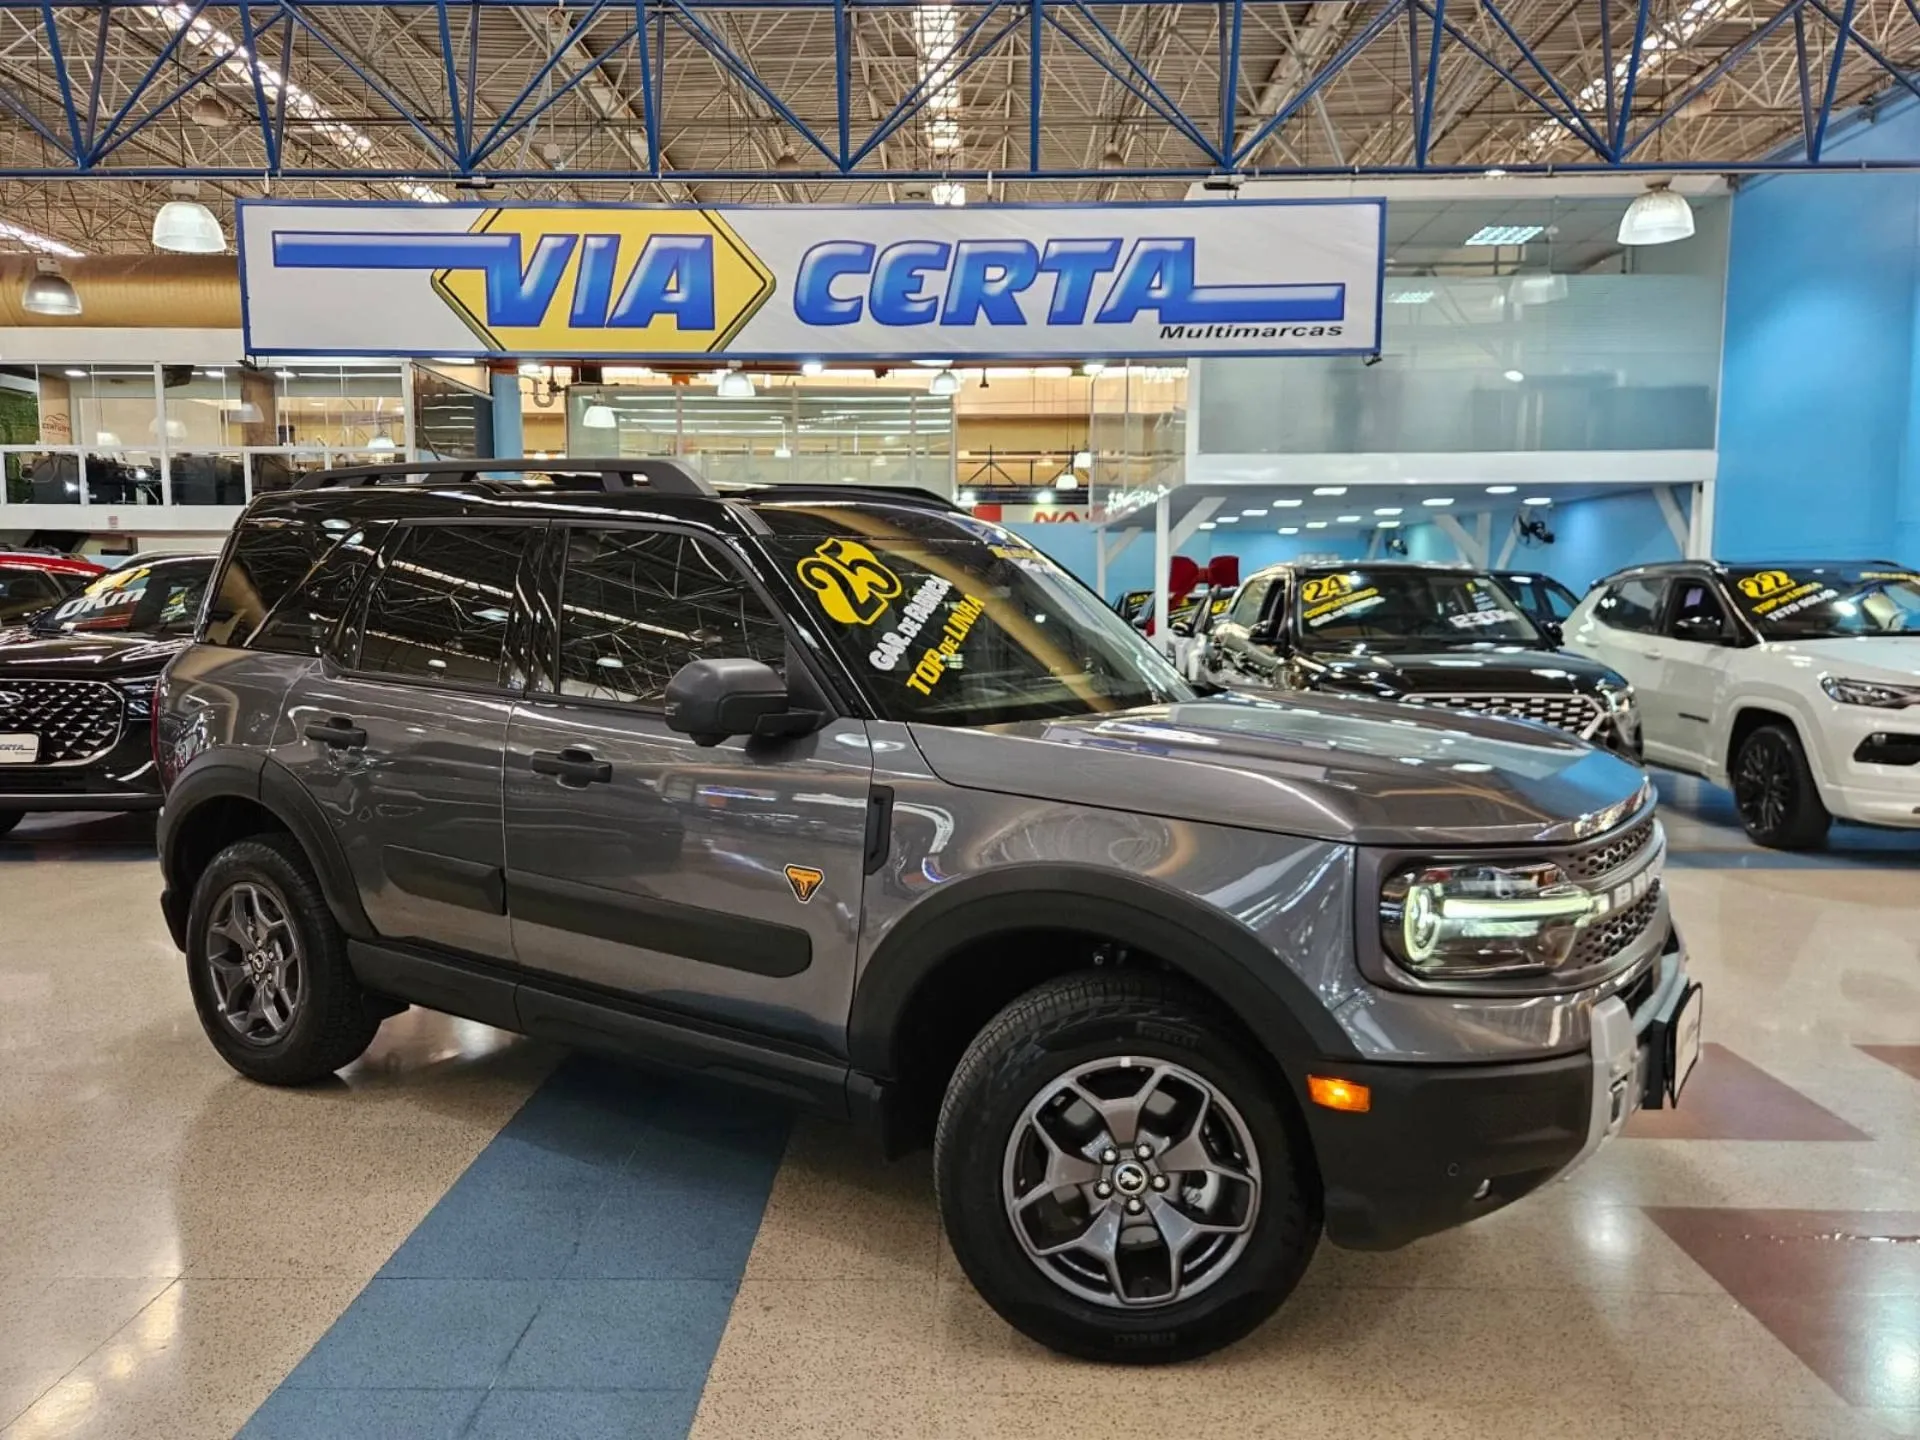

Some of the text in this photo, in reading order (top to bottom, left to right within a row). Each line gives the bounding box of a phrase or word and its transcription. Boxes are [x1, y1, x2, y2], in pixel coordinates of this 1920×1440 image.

[486, 233, 1196, 331] VIA CERTA
[1159, 324, 1343, 340] Multimarcas
[796, 537, 902, 625] 25
[1303, 574, 1353, 603] 24
[1737, 570, 1797, 599] 22
[898, 616, 922, 638] DE
[906, 593, 986, 696] TOP DE LINHA
